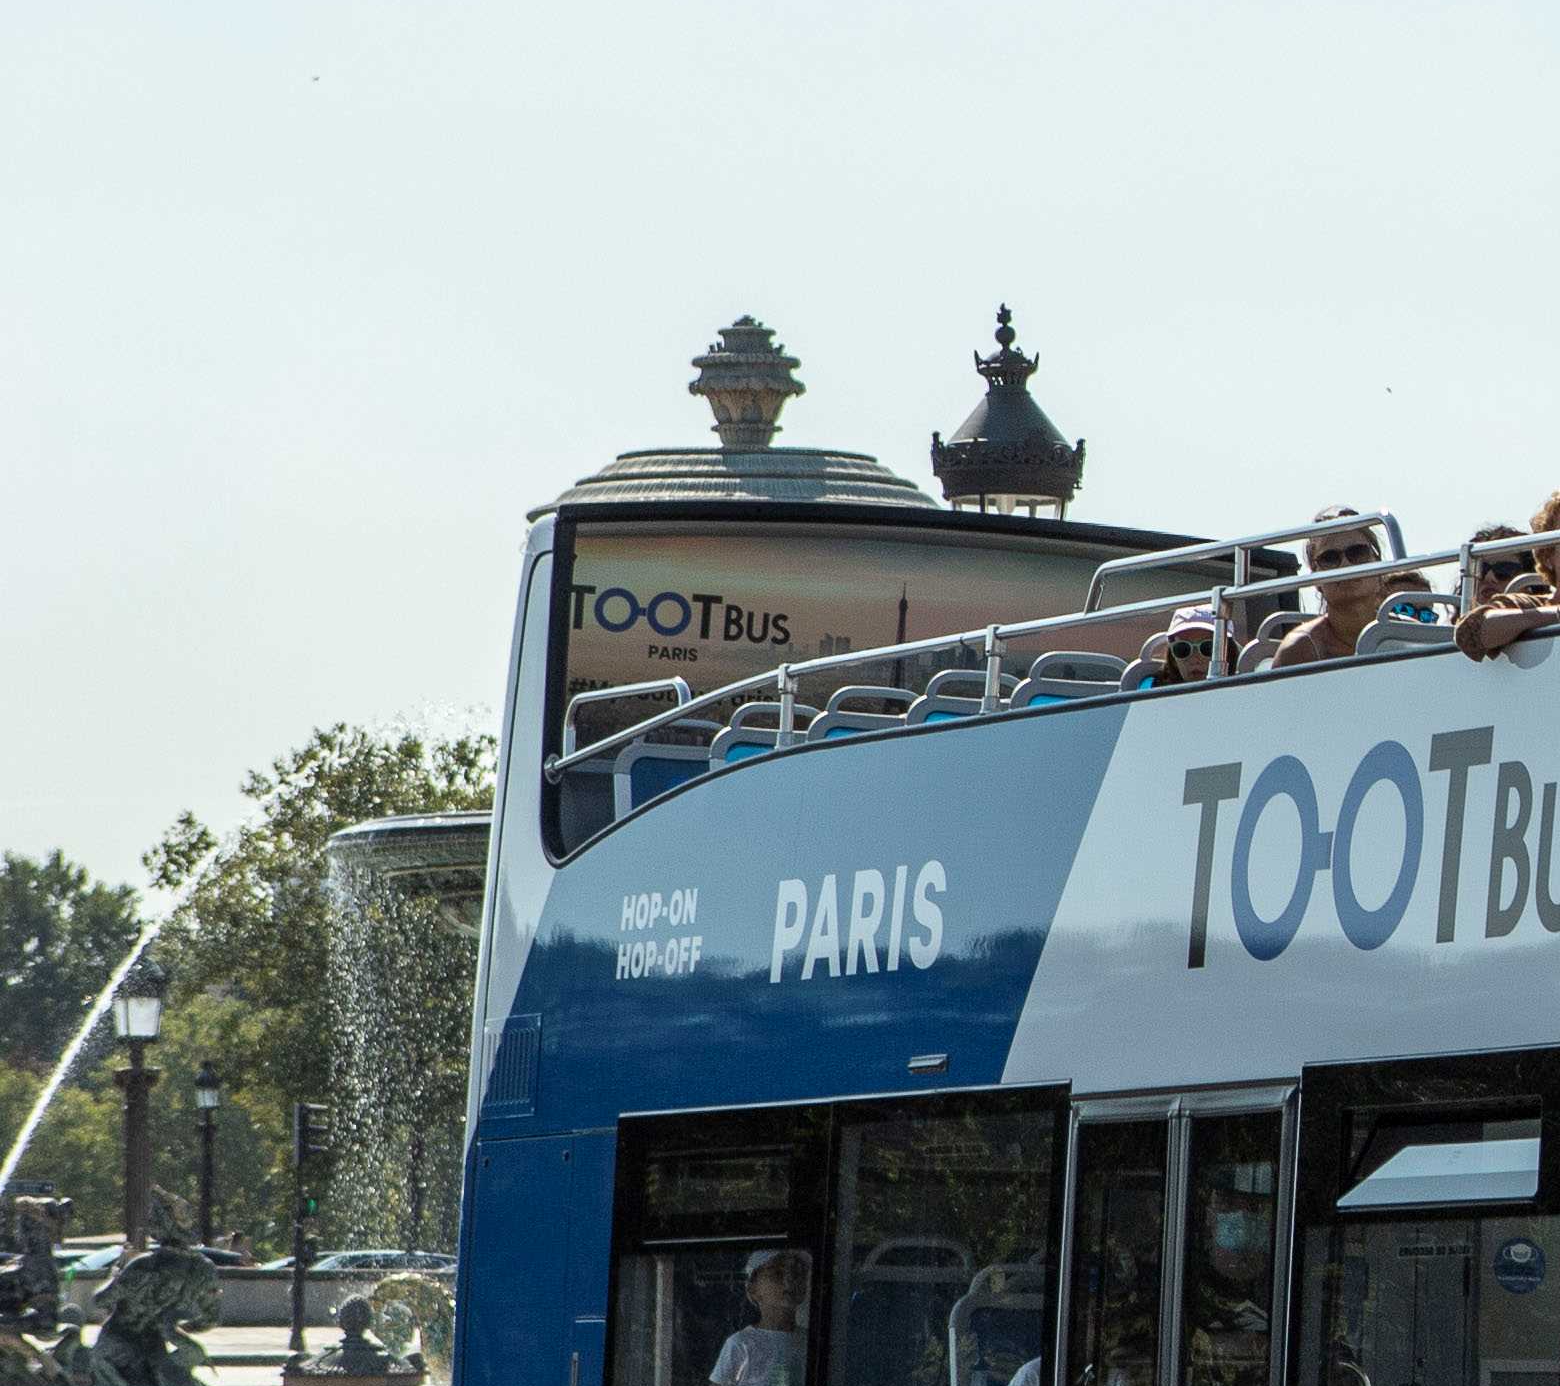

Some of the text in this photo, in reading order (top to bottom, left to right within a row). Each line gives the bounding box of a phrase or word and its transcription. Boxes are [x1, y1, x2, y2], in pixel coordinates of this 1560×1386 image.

[647, 644, 699, 663] PARIS
[620, 888, 699, 931] HOP-ON
[769, 859, 947, 984] PARIS
[615, 935, 703, 981] HOP-OFF
